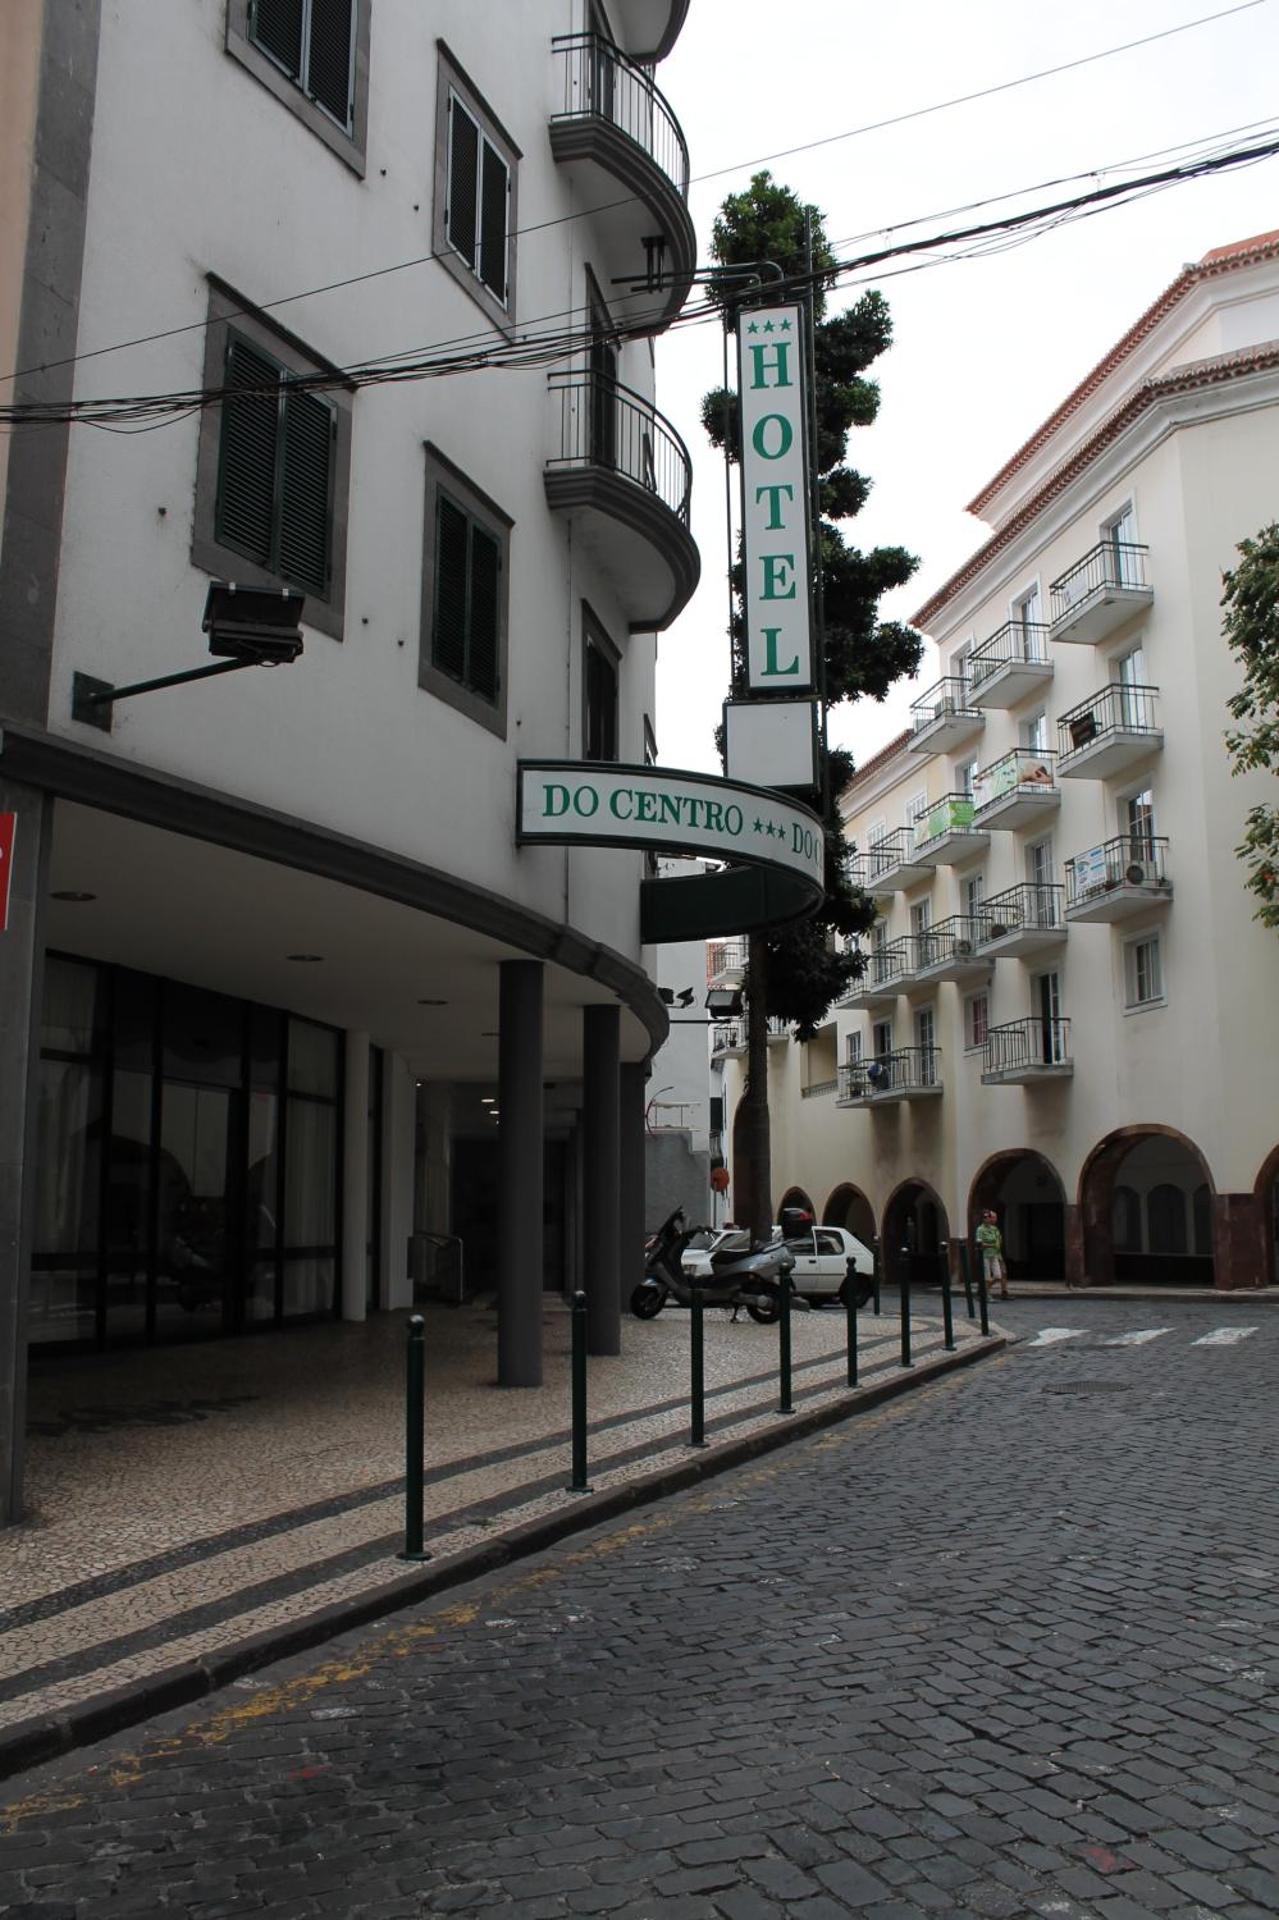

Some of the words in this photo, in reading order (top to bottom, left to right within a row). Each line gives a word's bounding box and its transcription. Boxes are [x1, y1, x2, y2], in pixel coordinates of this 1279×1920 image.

[749, 340, 800, 677] HOTEL
[541, 784, 599, 817] DO
[609, 788, 744, 836] CENTRO
[792, 822, 813, 859] DO
